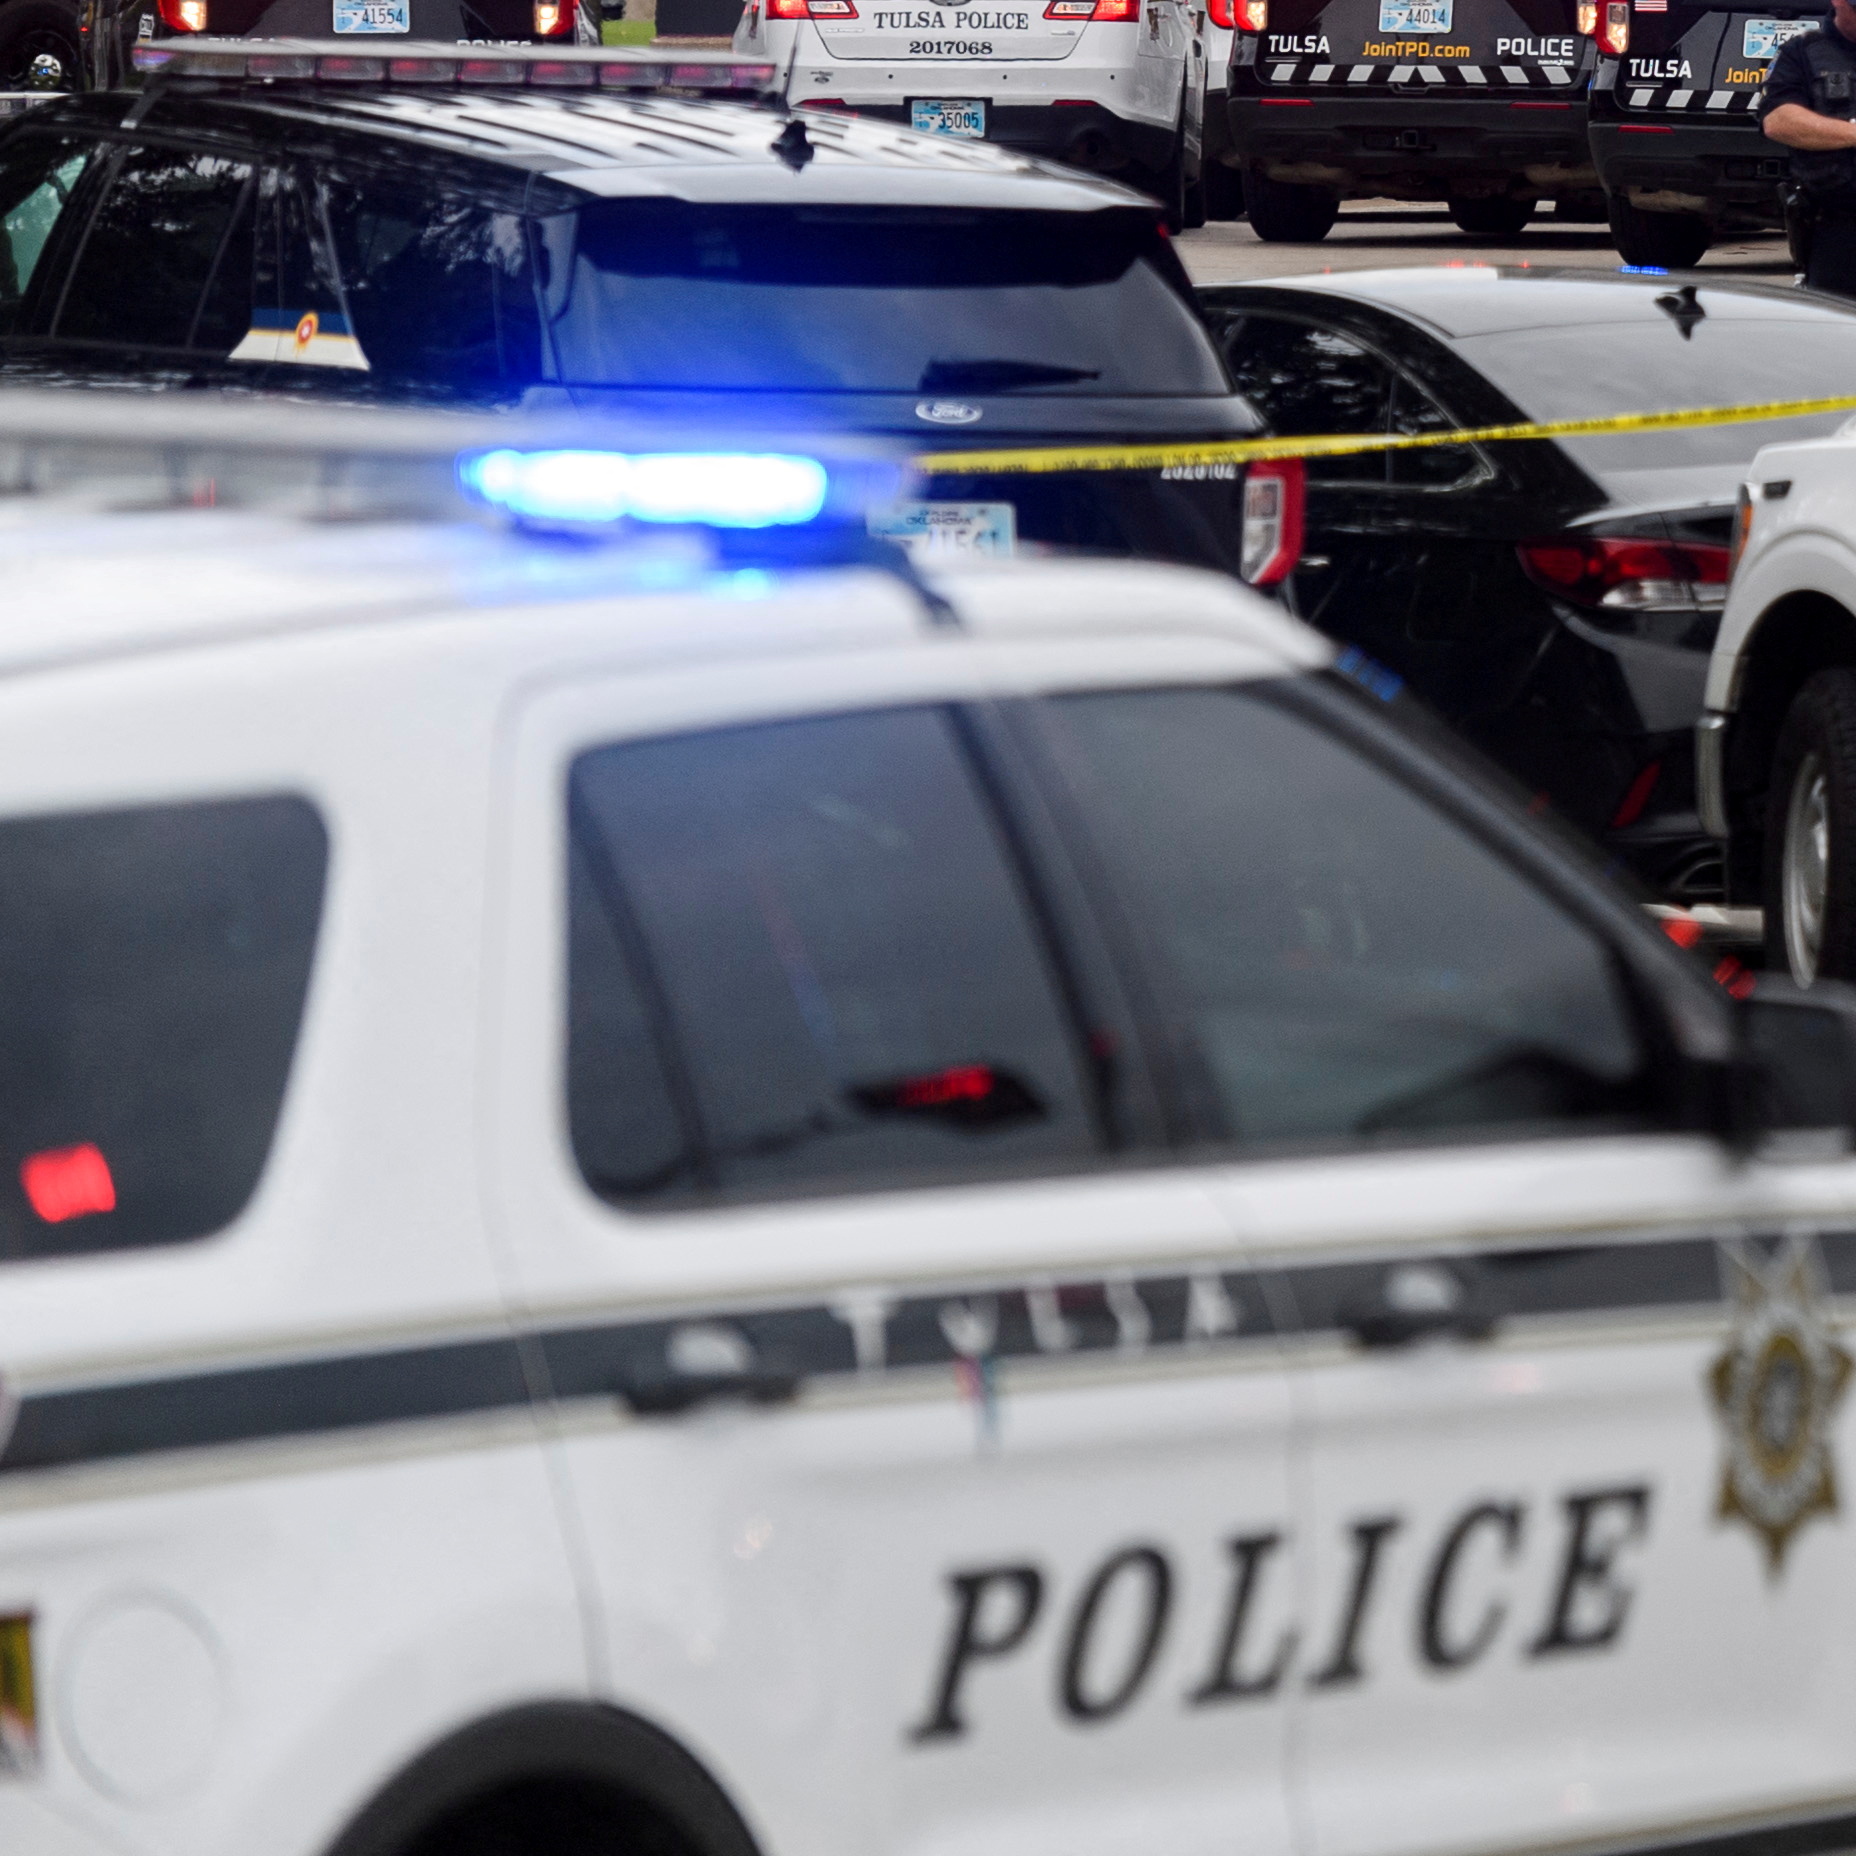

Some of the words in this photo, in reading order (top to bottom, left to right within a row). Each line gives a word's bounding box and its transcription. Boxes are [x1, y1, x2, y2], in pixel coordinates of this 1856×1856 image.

[362, 7, 403, 25] 41554
[874, 11, 945, 30] TULSA
[955, 12, 1029, 30] POLICE
[1405, 8, 1446, 25] 44014
[909, 40, 993, 55] 2017068
[1268, 34, 1331, 54] TULSA
[1362, 41, 1471, 58] JoinTPD.com
[1496, 37, 1574, 57] POLICE
[1629, 58, 1693, 79] TULSA
[938, 111, 980, 129] 35005
[906, 516, 973, 526] OKLAHOMA
[903, 1478, 1660, 1750] POLICE
